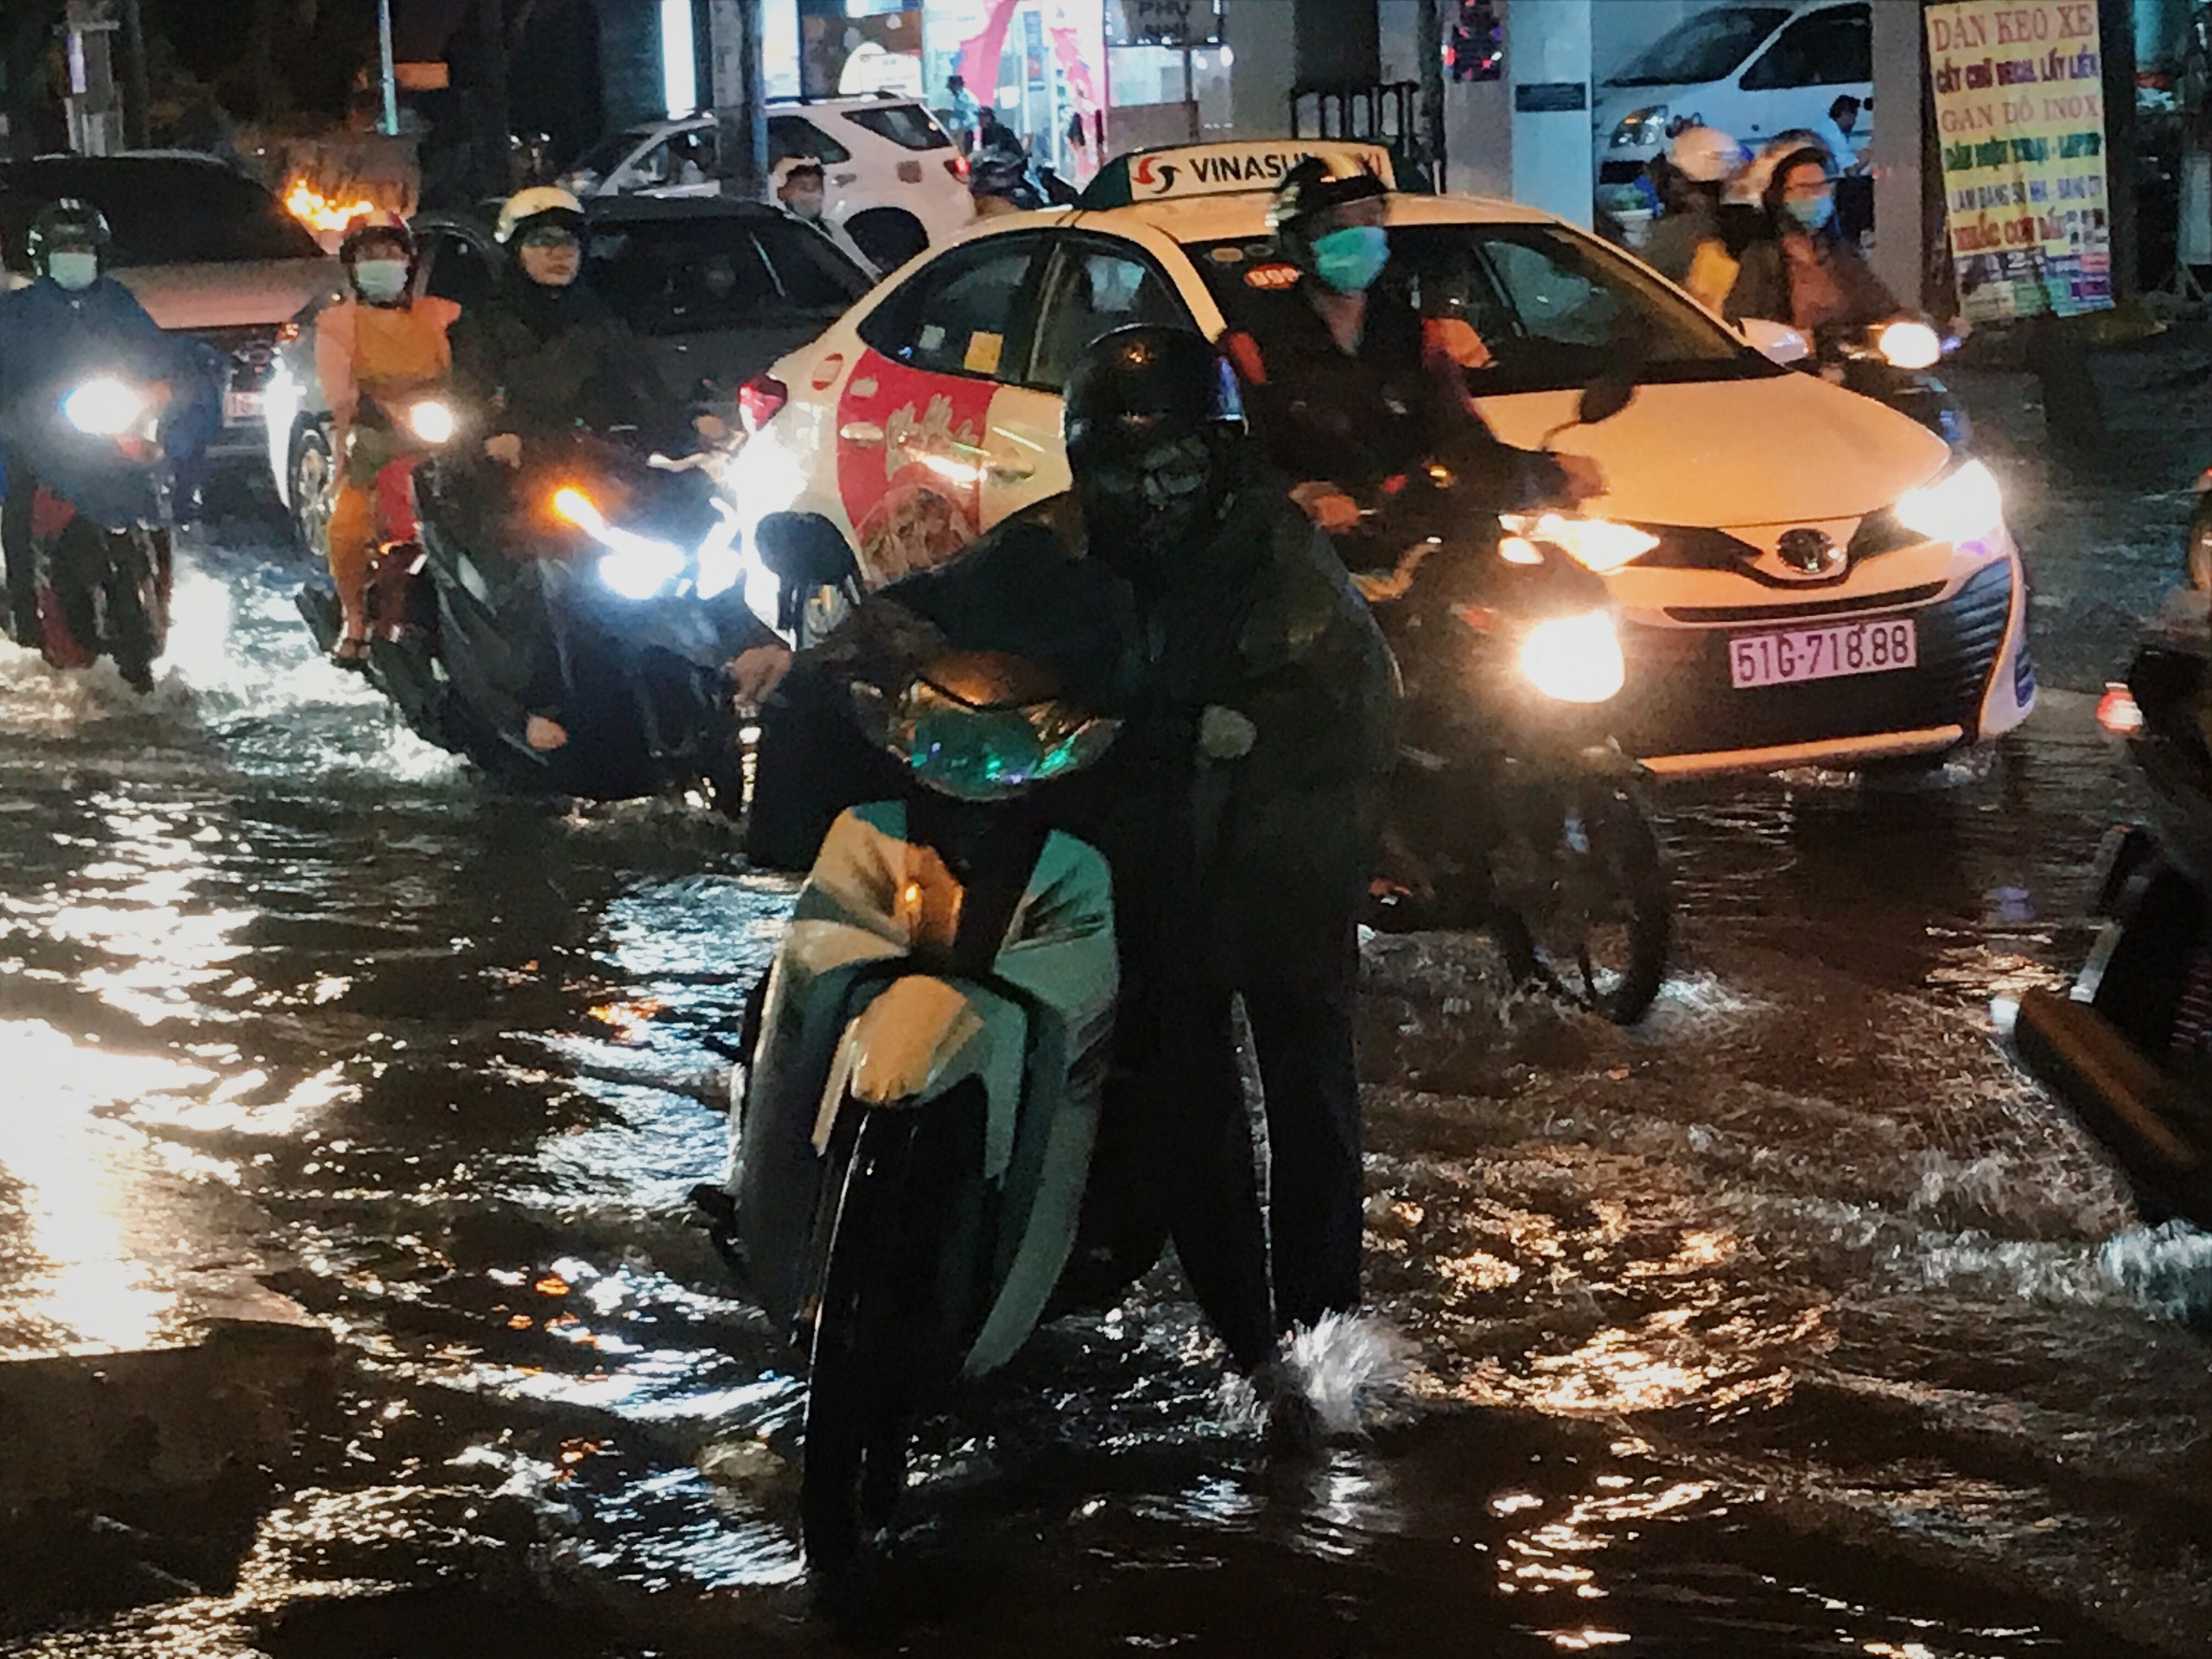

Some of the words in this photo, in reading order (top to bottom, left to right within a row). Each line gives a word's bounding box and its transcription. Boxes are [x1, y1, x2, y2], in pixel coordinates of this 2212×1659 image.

[2056, 4, 2094, 39] XE
[2043, 95, 2100, 122] INOX
[1737, 625, 1909, 682] 51G-718.88
